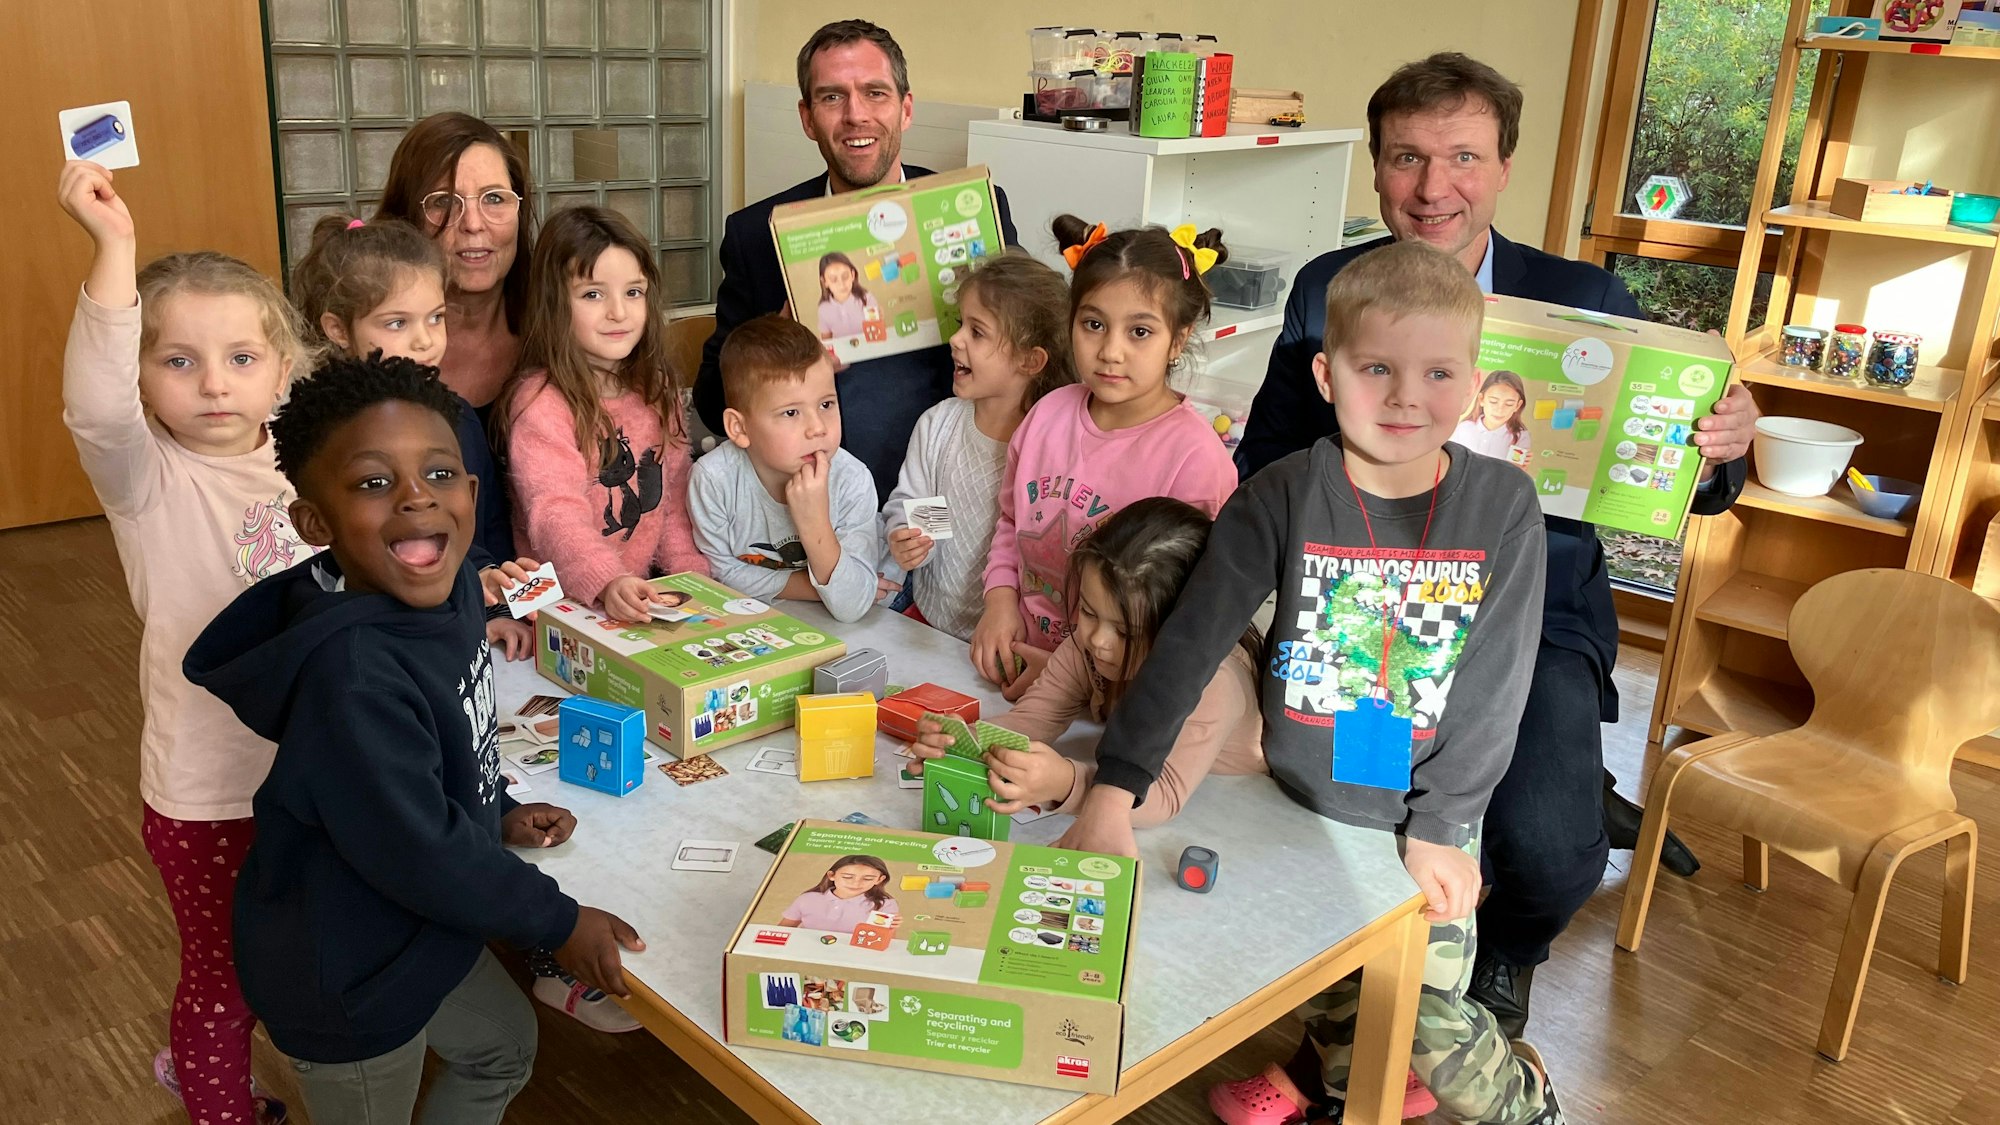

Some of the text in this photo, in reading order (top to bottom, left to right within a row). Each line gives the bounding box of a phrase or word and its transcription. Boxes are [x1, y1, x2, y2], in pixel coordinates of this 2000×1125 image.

[1146, 74, 1170, 86] GIULIA
[1145, 88, 1176, 96] LEANDRA
[1144, 97, 1178, 109] CAROLINA
[1151, 111, 1177, 126] LAURA
[1523, 346, 1559, 360] recycling
[1336, 548, 1353, 557] OUR
[1355, 549, 1387, 557] PLANET
[1400, 550, 1437, 558] MILLION
[1439, 551, 1461, 559] YEARS
[1463, 551, 1480, 559] AGO
[1303, 553, 1480, 586] TYRANNOSAURUS
[1419, 575, 1486, 604] ROOA
[1278, 640, 1308, 661] SO
[810, 831, 928, 849] Separating and recycling
[759, 930, 789, 938] akros
[1083, 971, 1100, 979] 3-8
[927, 1008, 1012, 1028] Separating and
[926, 1019, 976, 1034] recycling
[926, 1029, 959, 1040] Separar
[968, 1036, 1000, 1045] reciclar
[1071, 1031, 1095, 1042] friendly
[926, 1038, 946, 1048] Trier
[958, 1043, 991, 1054] recycler
[1057, 1055, 1089, 1067] akros
